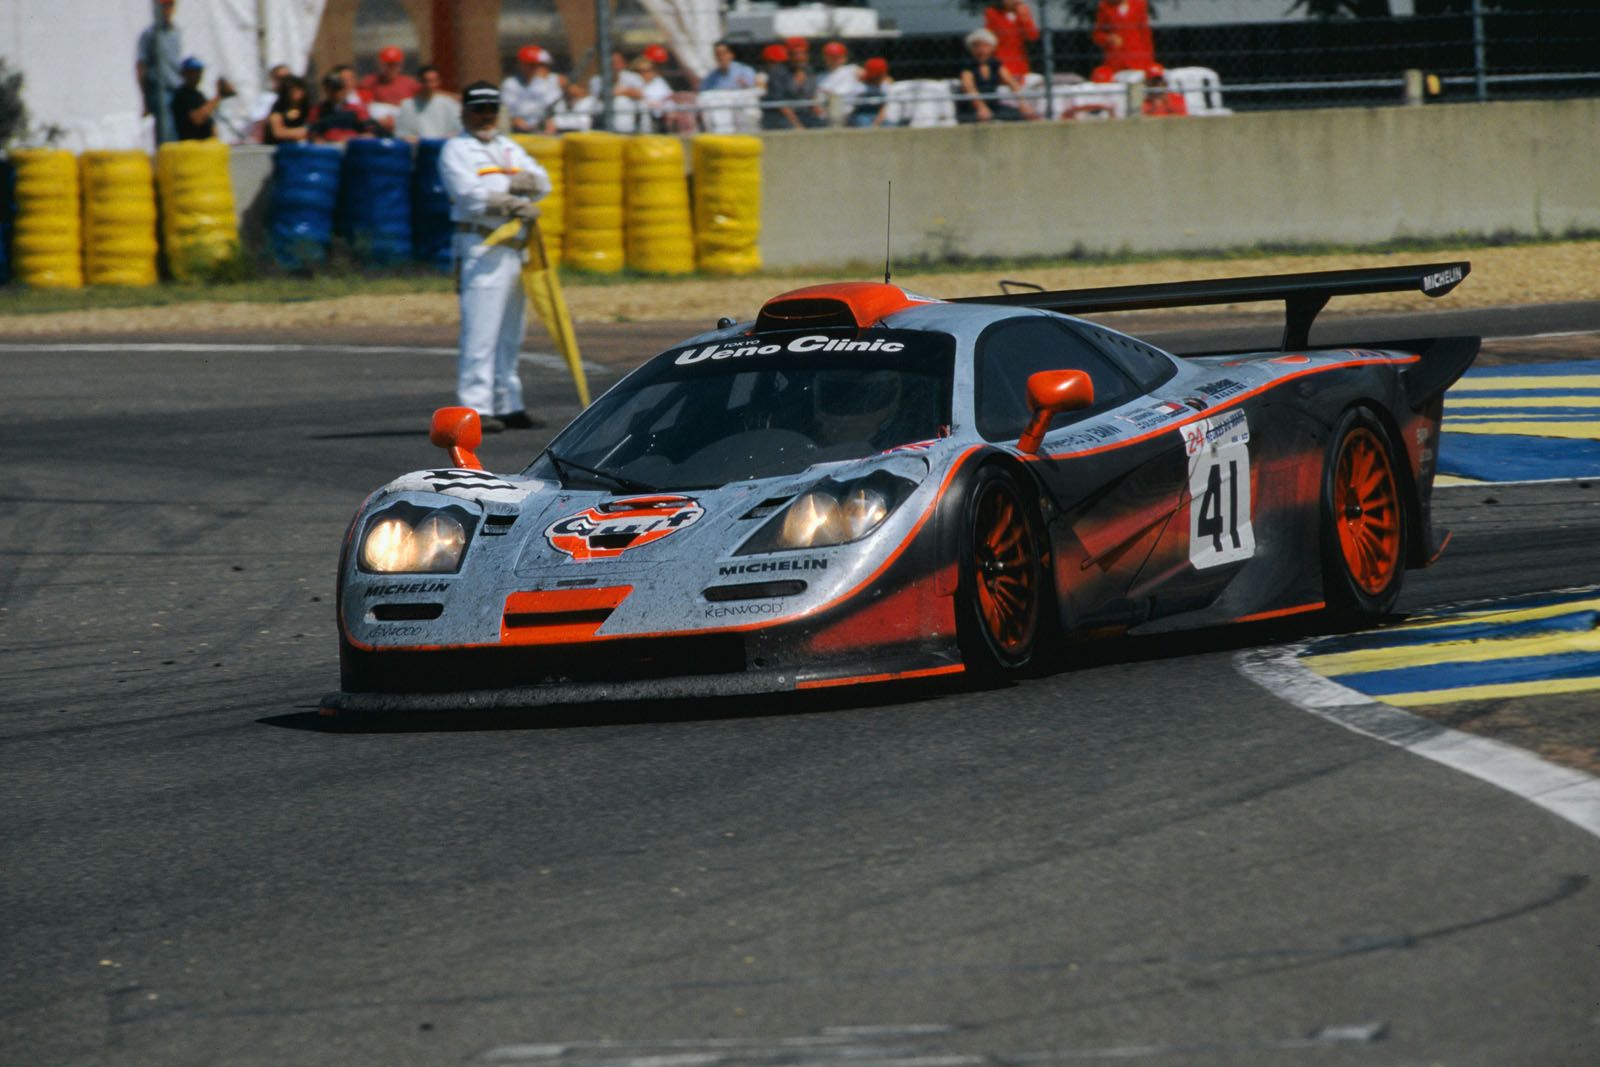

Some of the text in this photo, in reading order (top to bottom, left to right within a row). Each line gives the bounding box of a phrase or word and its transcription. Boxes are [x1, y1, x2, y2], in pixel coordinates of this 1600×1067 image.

[674, 335, 905, 365] Ueno Clinic
[1187, 426, 1204, 454] 24
[1198, 460, 1241, 553] 41
[552, 510, 697, 537] Gulf
[719, 559, 828, 576] MICHELIN
[363, 583, 450, 599] MICHELIN
[705, 602, 784, 619] KENWOOD
